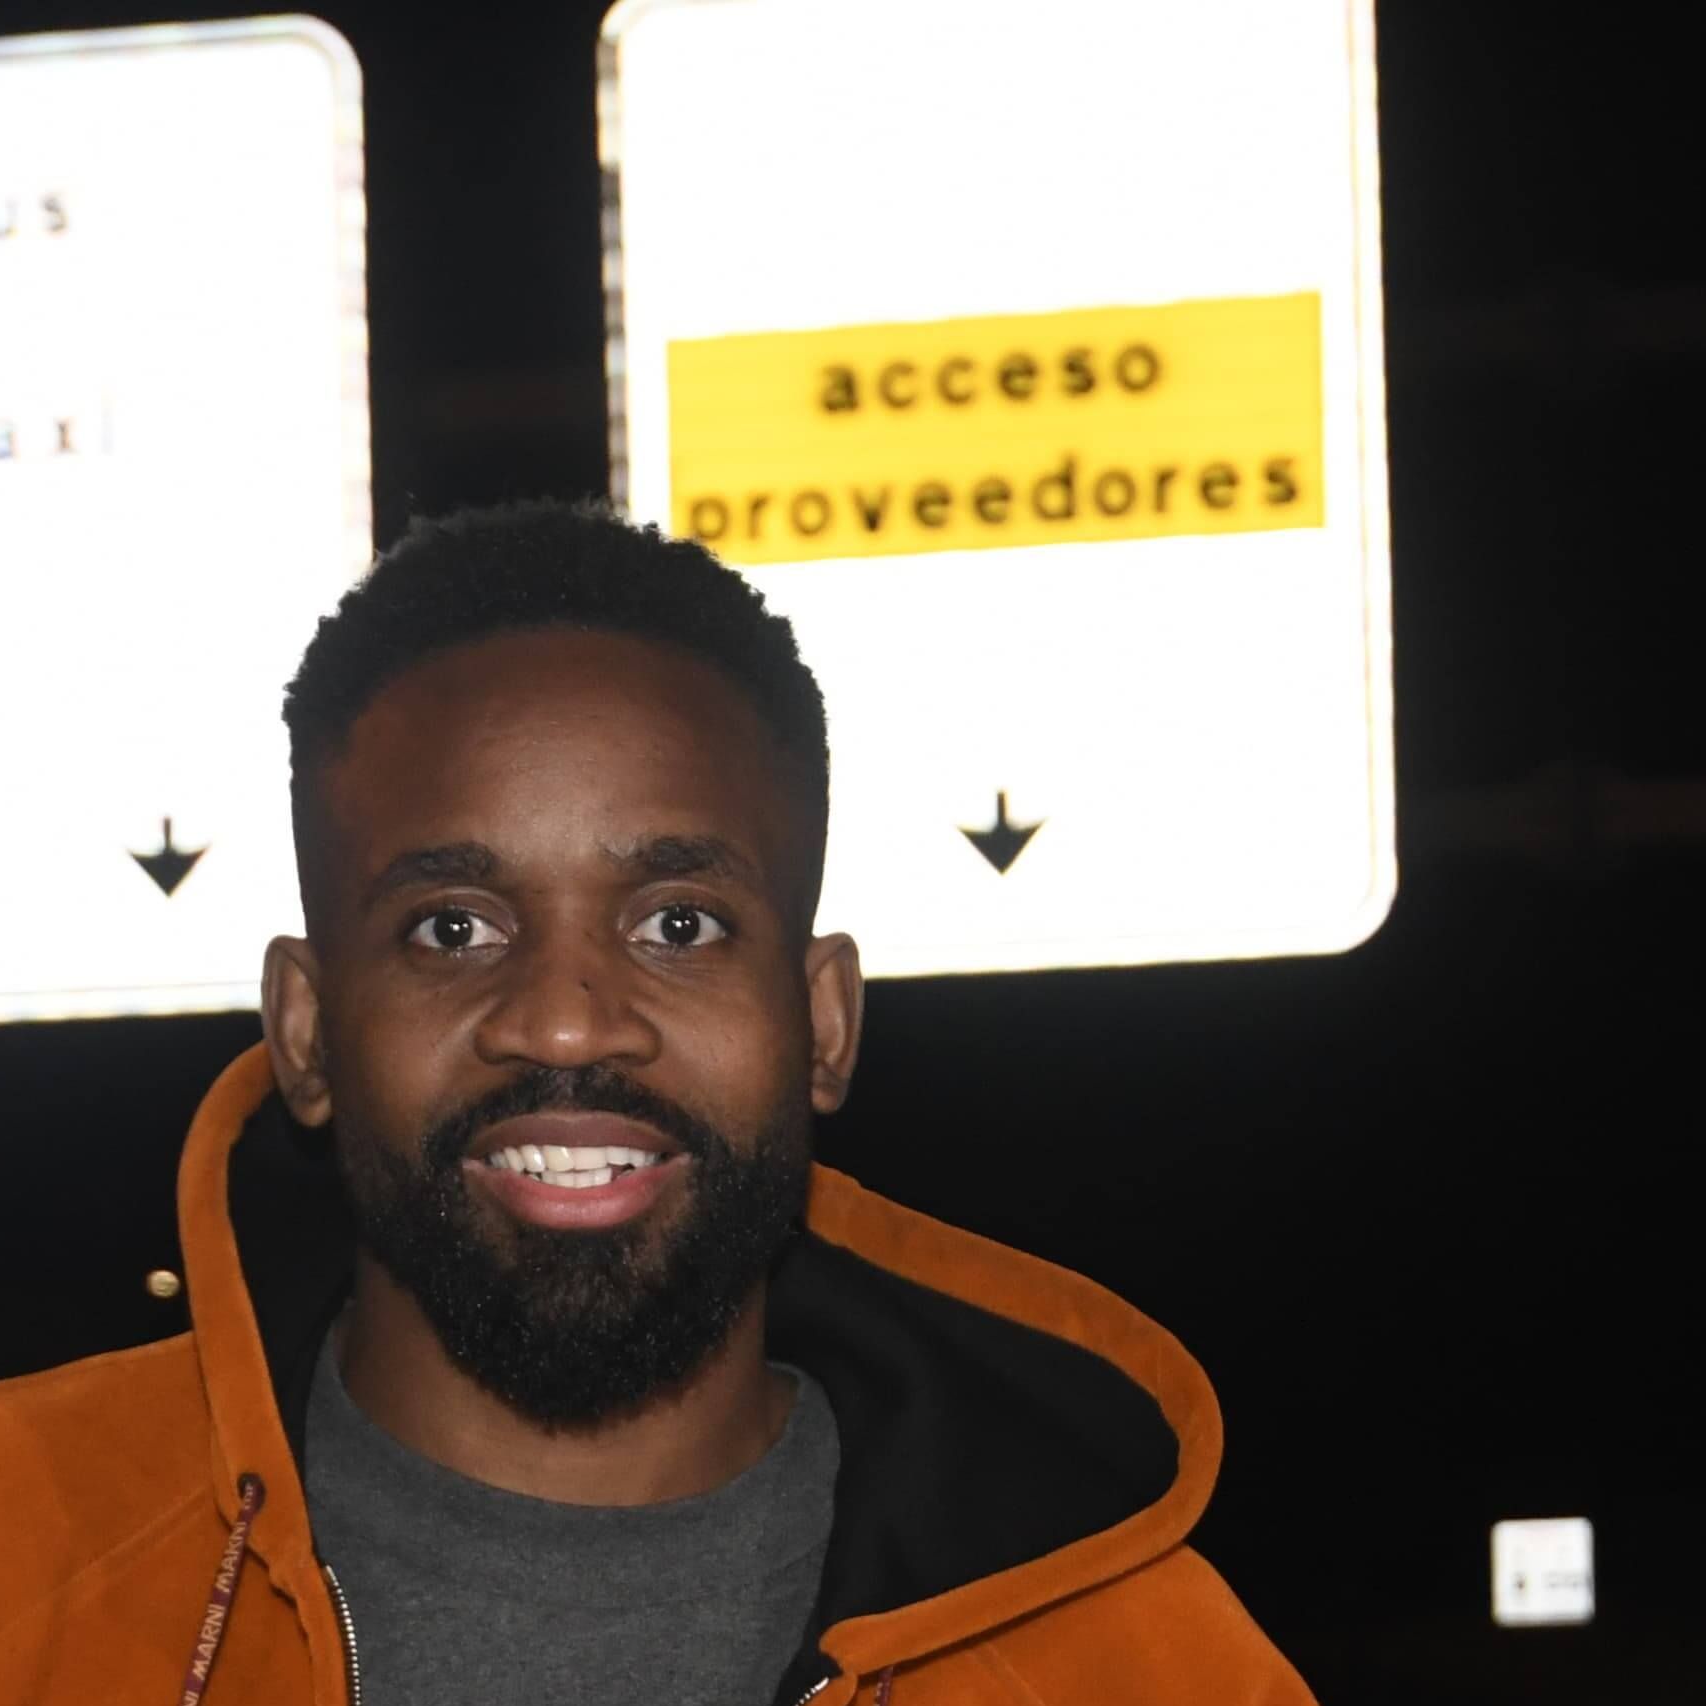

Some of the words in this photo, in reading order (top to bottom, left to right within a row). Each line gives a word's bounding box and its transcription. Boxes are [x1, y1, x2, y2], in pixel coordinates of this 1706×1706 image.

[819, 341, 1164, 415] acceso
[690, 455, 1301, 546] proveedores
[193, 1602, 228, 1682] MARNI
